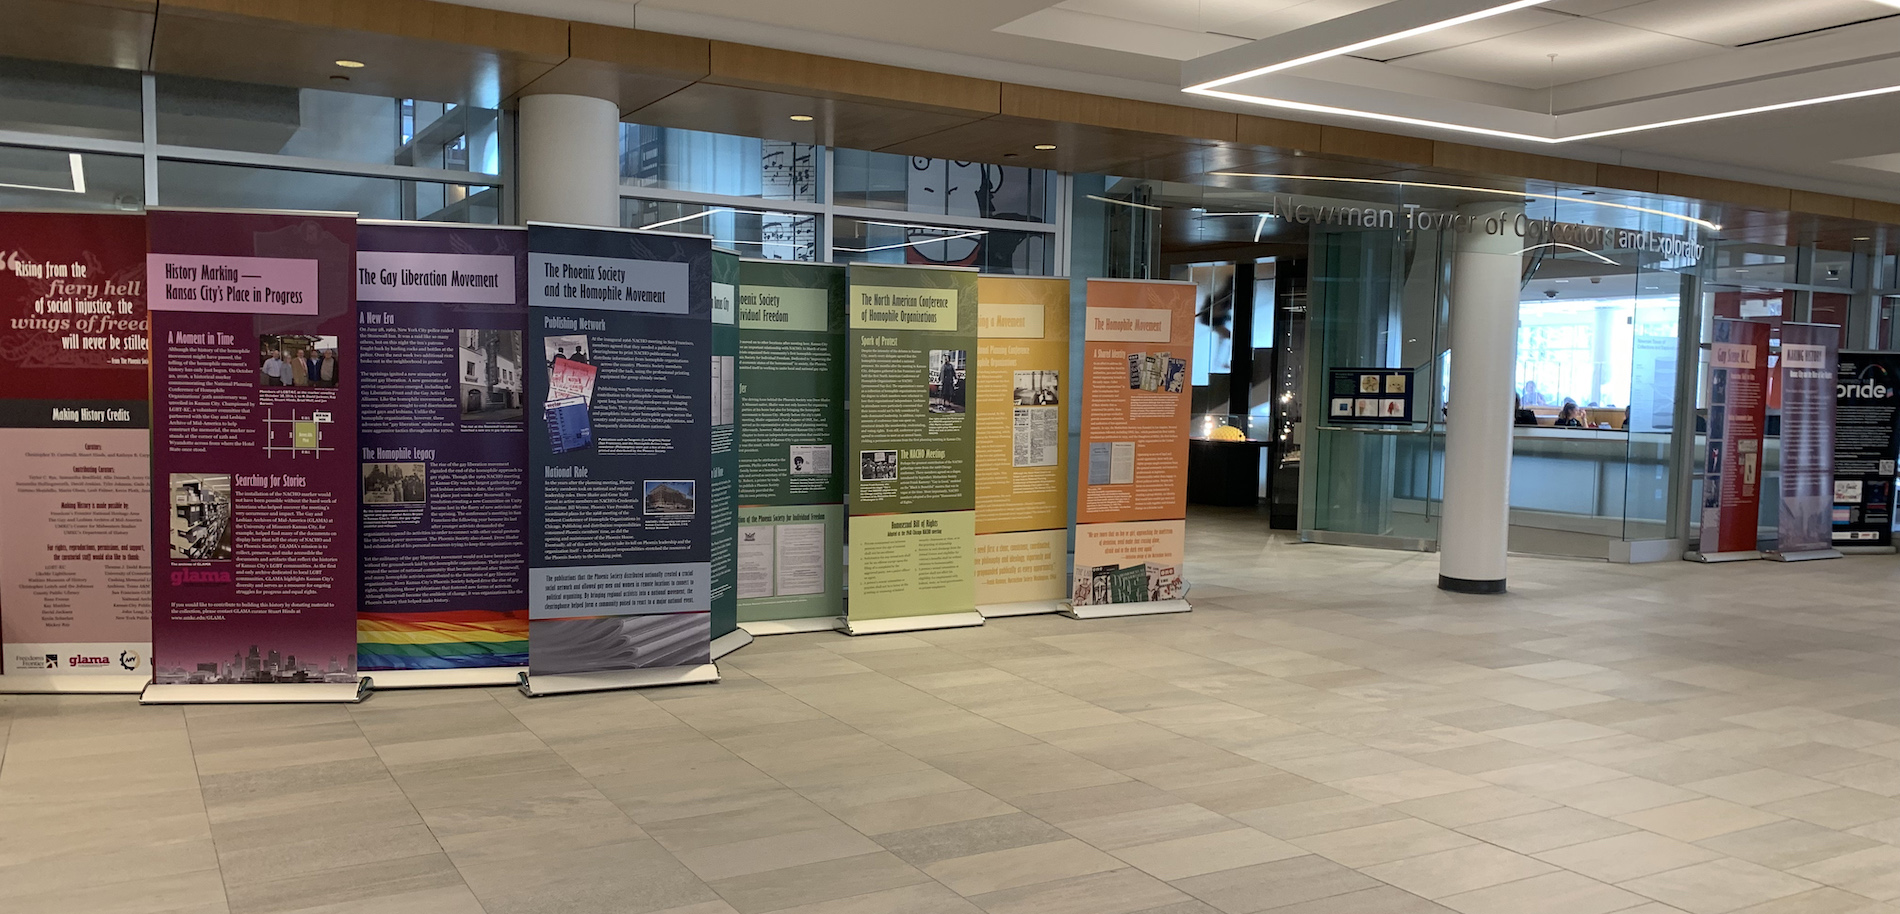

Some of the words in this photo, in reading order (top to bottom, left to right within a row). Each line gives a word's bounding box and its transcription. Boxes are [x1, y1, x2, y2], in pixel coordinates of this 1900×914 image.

[1273, 196, 1393, 228] Newman
[1403, 204, 1477, 234] Tower
[1485, 211, 1507, 236] of
[1514, 212, 1614, 248] Collections
[1619, 230, 1646, 250] and
[46, 260, 68, 279] from
[71, 262, 86, 278] the
[166, 263, 197, 282] History
[201, 265, 238, 282] Marking
[544, 262, 559, 278] The
[563, 264, 594, 280] Phoenix
[598, 266, 626, 284] Society
[359, 268, 376, 285] The
[380, 269, 397, 287] Gay
[401, 269, 447, 286] Liberation
[451, 270, 499, 288] Movement
[45, 280, 98, 298] fiery
[104, 280, 140, 296] hell
[166, 284, 196, 300] Kansas
[227, 286, 249, 302] Place
[253, 286, 261, 302] in
[266, 287, 302, 305] Progress
[544, 283, 559, 297] and
[564, 283, 577, 298] the
[580, 283, 622, 301] Homophile
[626, 286, 666, 303] Movement
[35, 297, 44, 314] of
[47, 298, 72, 313] social
[76, 298, 115, 316] injustice,
[118, 298, 133, 314] the
[759, 293, 780, 308] Society
[862, 293, 872, 306] The
[874, 294, 890, 306] North
[892, 294, 917, 307] American
[919, 295, 948, 308] Conference
[360, 312, 364, 324] A
[367, 312, 381, 324] New
[384, 312, 394, 324] Era
[763, 309, 788, 322] Freedom
[861, 309, 868, 322] of
[869, 309, 898, 323] Homophile
[901, 310, 937, 323] Organizations
[996, 315, 1025, 327] Movement
[10, 314, 70, 333] wings
[75, 315, 98, 334] of
[544, 316, 577, 331] Publishing
[579, 317, 606, 331] Network
[1095, 318, 1104, 330] The
[1106, 318, 1132, 332] Homophile
[1134, 319, 1161, 332] Movement
[62, 334, 80, 350] will
[82, 336, 107, 350] never
[110, 334, 120, 350] be
[168, 331, 173, 344] A
[176, 331, 205, 345] Moment
[208, 331, 214, 345] in
[217, 332, 234, 346] Time
[861, 335, 874, 347] Spark
[875, 336, 880, 346] of
[882, 336, 898, 346] Protest
[52, 408, 79, 422] Making
[80, 408, 105, 422] History
[106, 408, 130, 422] Credits
[362, 447, 375, 459] The
[377, 447, 411, 460] Homophile
[414, 447, 436, 460] Legacy
[900, 449, 908, 459] The
[910, 449, 925, 459] NACHO
[926, 448, 945, 459] Meetings
[545, 466, 572, 478] National
[574, 466, 588, 478] Role
[235, 473, 268, 488] Searching
[270, 474, 281, 487] for
[283, 474, 306, 487] Stories
[171, 568, 231, 586] glama
[69, 654, 110, 666] glama
